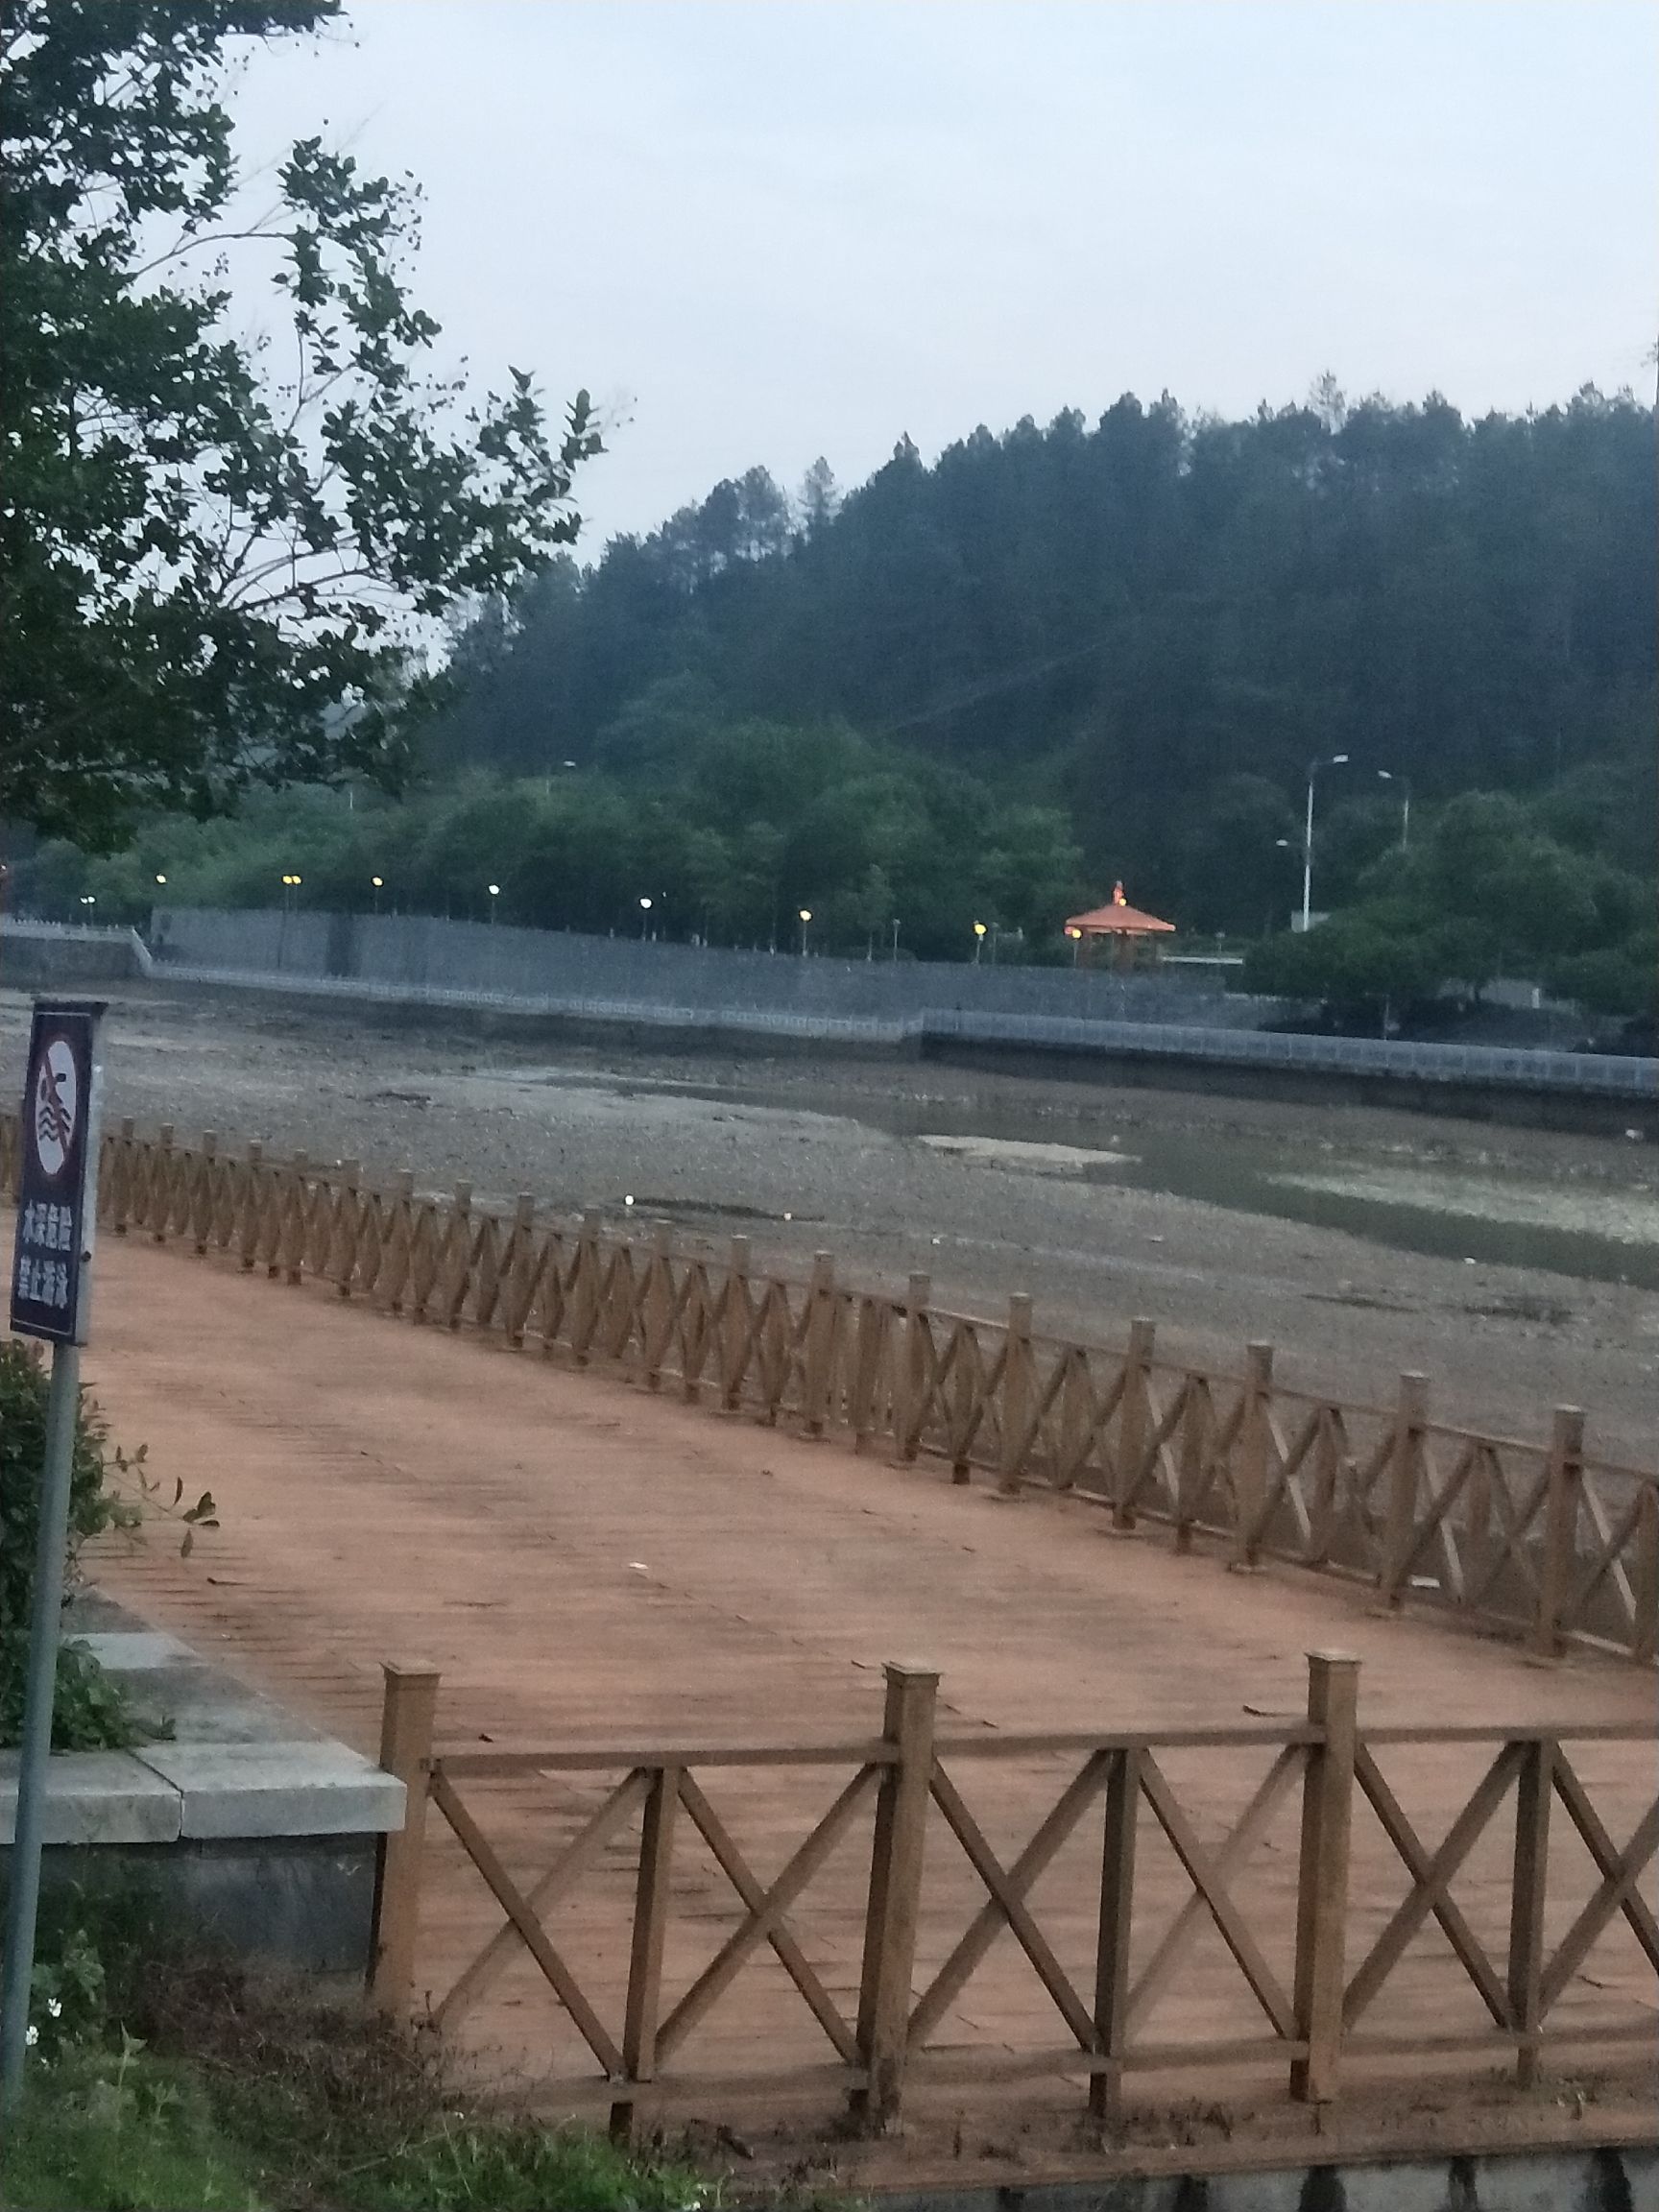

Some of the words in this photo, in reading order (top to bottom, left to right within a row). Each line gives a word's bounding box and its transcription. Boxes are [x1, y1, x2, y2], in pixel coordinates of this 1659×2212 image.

[22, 1198, 72, 1252] 水深危险
[17, 1255, 68, 1309] 禁止游泳
